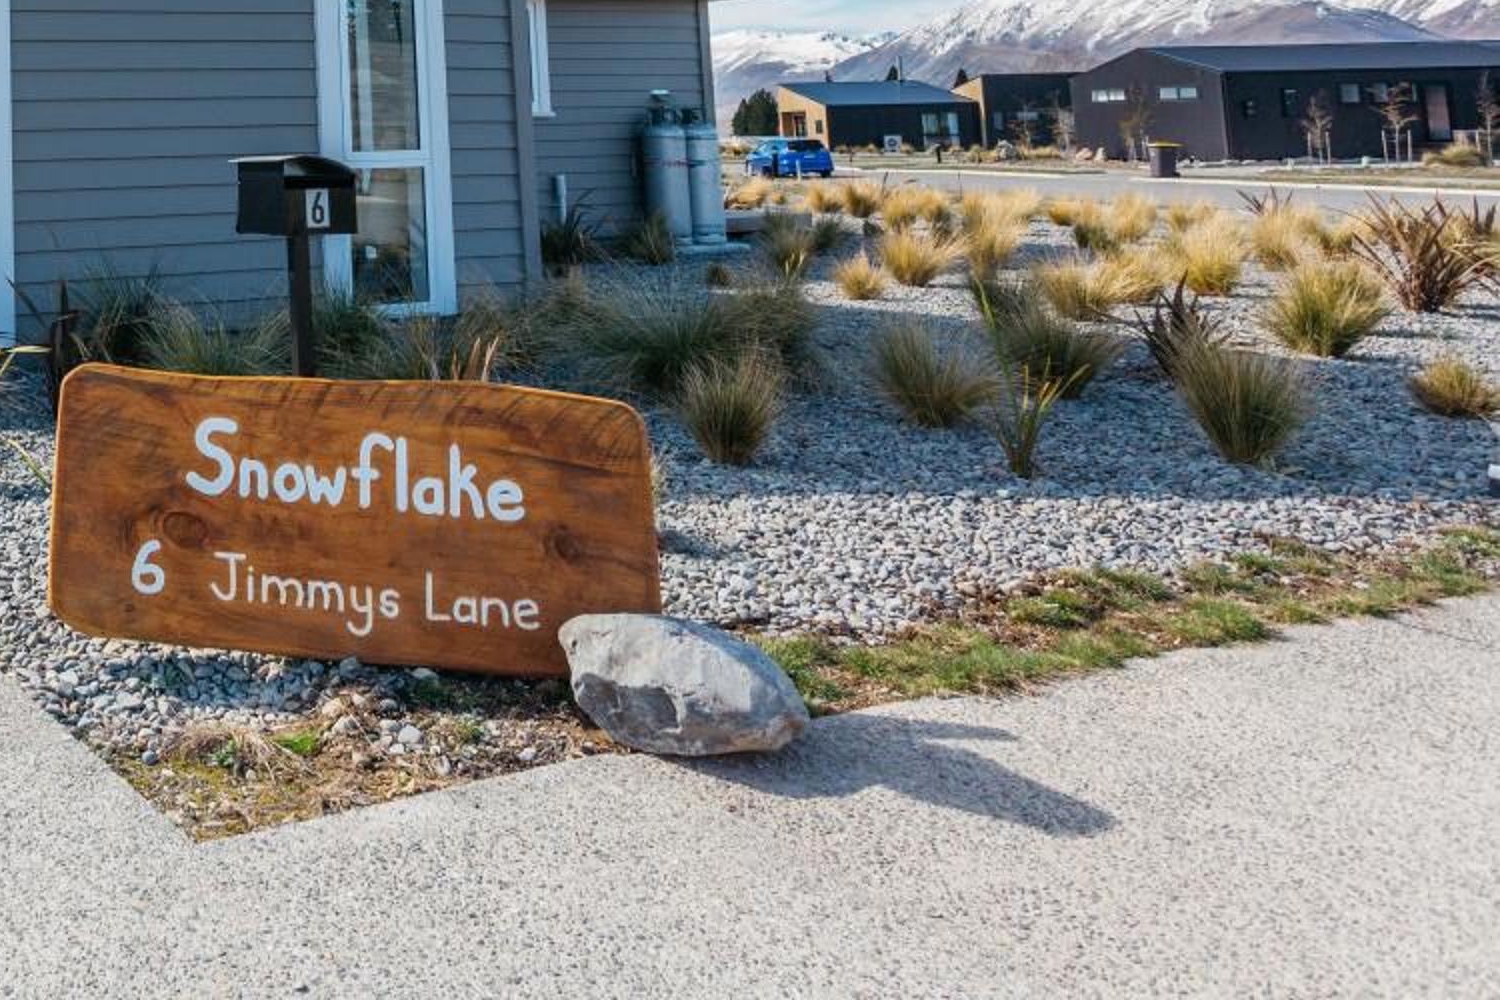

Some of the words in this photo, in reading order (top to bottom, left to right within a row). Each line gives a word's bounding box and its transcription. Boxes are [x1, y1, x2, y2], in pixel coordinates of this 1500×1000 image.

[312, 191, 325, 224] 6
[186, 417, 526, 522] Snowflake
[130, 539, 165, 595] 6
[209, 551, 401, 637] Jimmys
[424, 570, 541, 630] Lane
